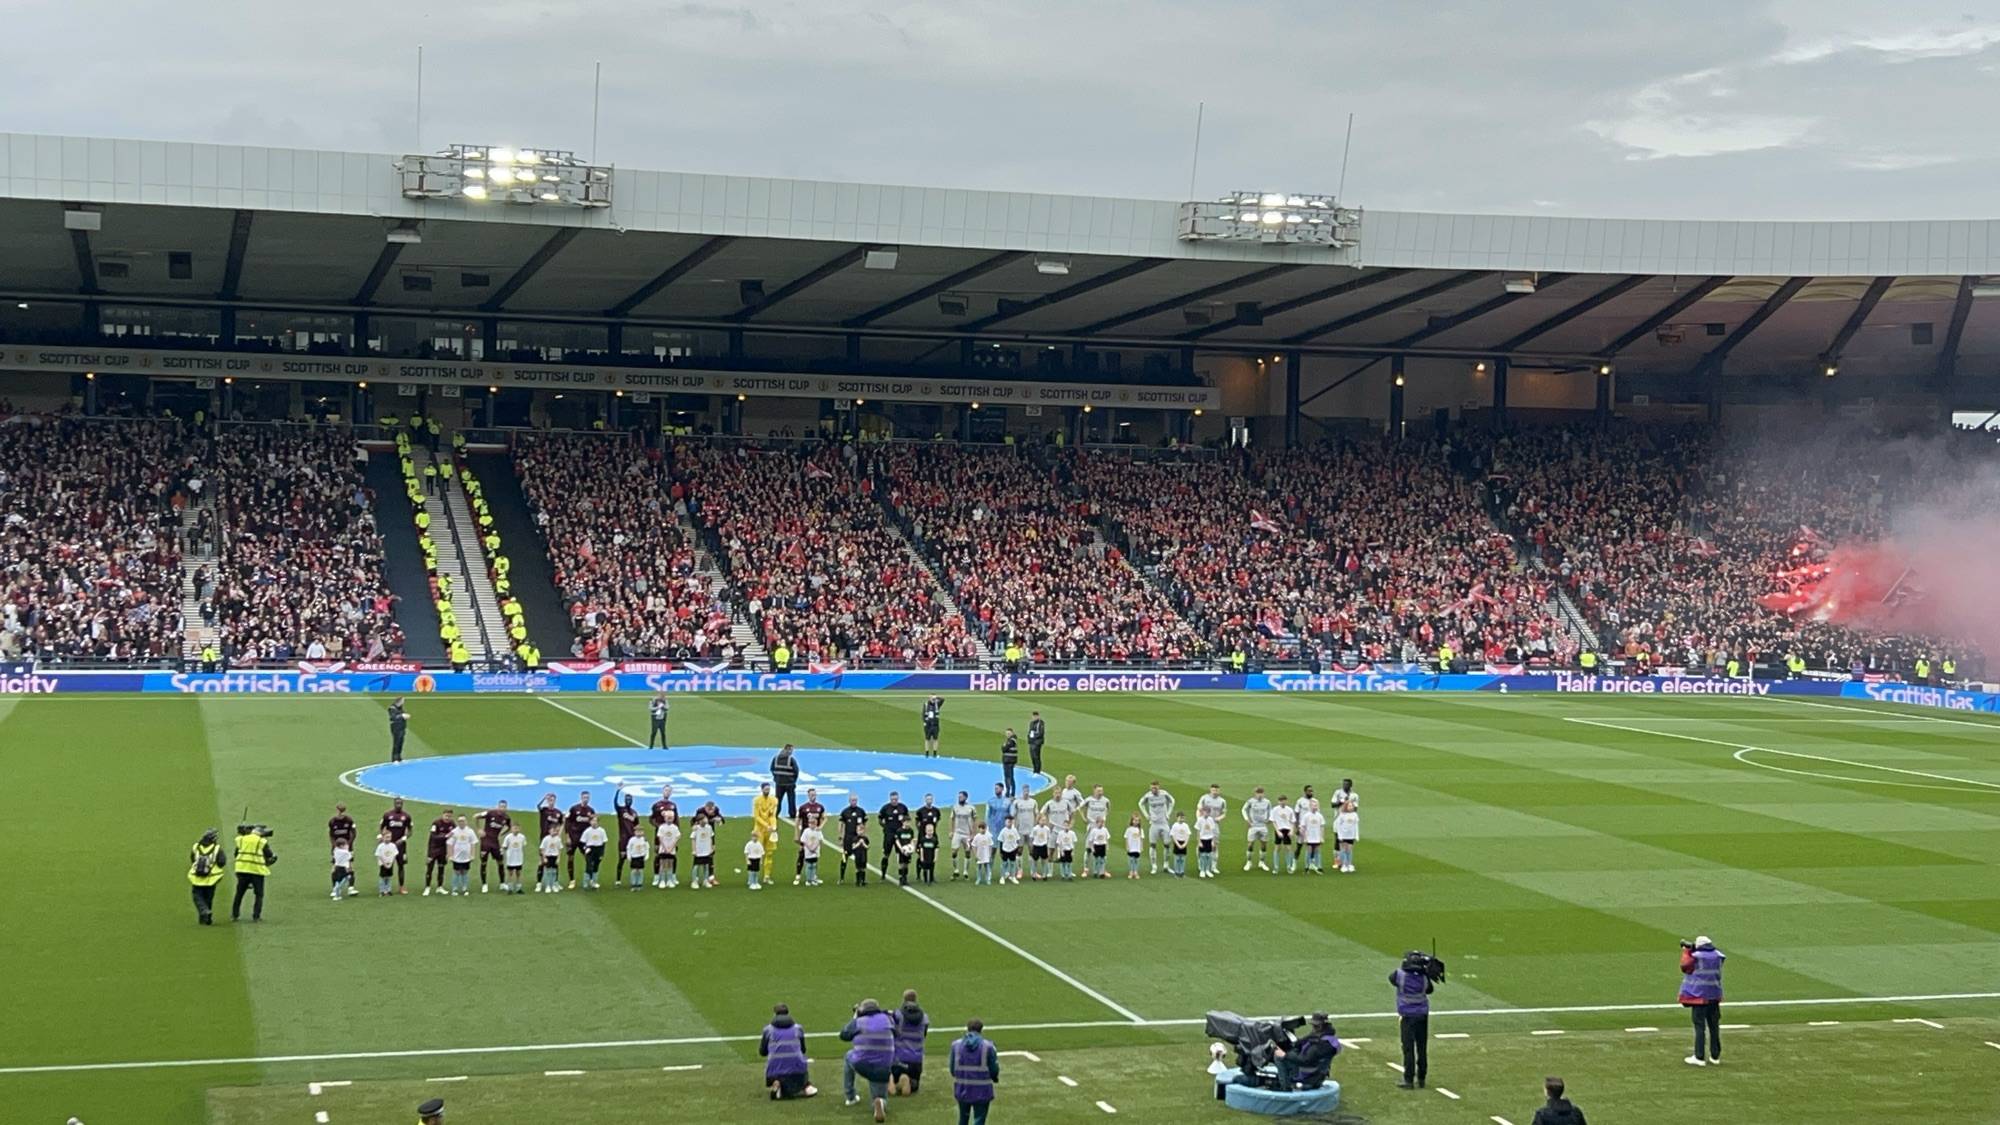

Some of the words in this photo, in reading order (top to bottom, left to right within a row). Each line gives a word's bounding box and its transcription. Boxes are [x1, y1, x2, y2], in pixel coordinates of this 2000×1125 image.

[40, 353, 99, 365] SCOTTISH
[105, 355, 129, 366] CUP
[163, 357, 221, 369] SCOTTISH
[227, 360, 250, 370] CUP
[283, 362, 341, 374] SCOTTISH
[345, 364, 368, 375] CUP
[400, 366, 456, 378] SCOTTISH
[461, 368, 483, 379] CUP
[514, 370, 569, 381] SCOTTISH
[573, 372, 595, 383] CUP
[625, 374, 678, 386] SCOTTISH
[682, 376, 704, 387] CUP
[733, 378, 785, 390] SCOTTISH
[789, 380, 809, 391] CUP
[838, 382, 888, 393] SCOTTISH
[891, 384, 912, 394] CUP
[940, 385, 989, 396] SCOTTISH
[992, 387, 1013, 398] CUP
[1040, 389, 1088, 400] SCOTTISH
[1091, 391, 1111, 401] CUP
[1137, 392, 1185, 402] SCOTTISH
[1188, 393, 1208, 403] CUP
[356, 663, 416, 671] GREENOCK
[171, 673, 290, 692] Scottish
[298, 673, 351, 692] Gas
[646, 673, 752, 691] Scottish
[759, 673, 806, 691] Gas
[970, 673, 1011, 690] Half
[1017, 673, 1070, 690] price
[1076, 673, 1181, 691] electricity
[1268, 674, 1361, 691] Scottish
[1366, 674, 1408, 691] Gas
[1556, 674, 1597, 692] Half
[1602, 676, 1655, 692] price
[1661, 678, 1770, 695] electricity
[1865, 682, 1941, 708] Scottish
[1944, 689, 1974, 710] Gas
